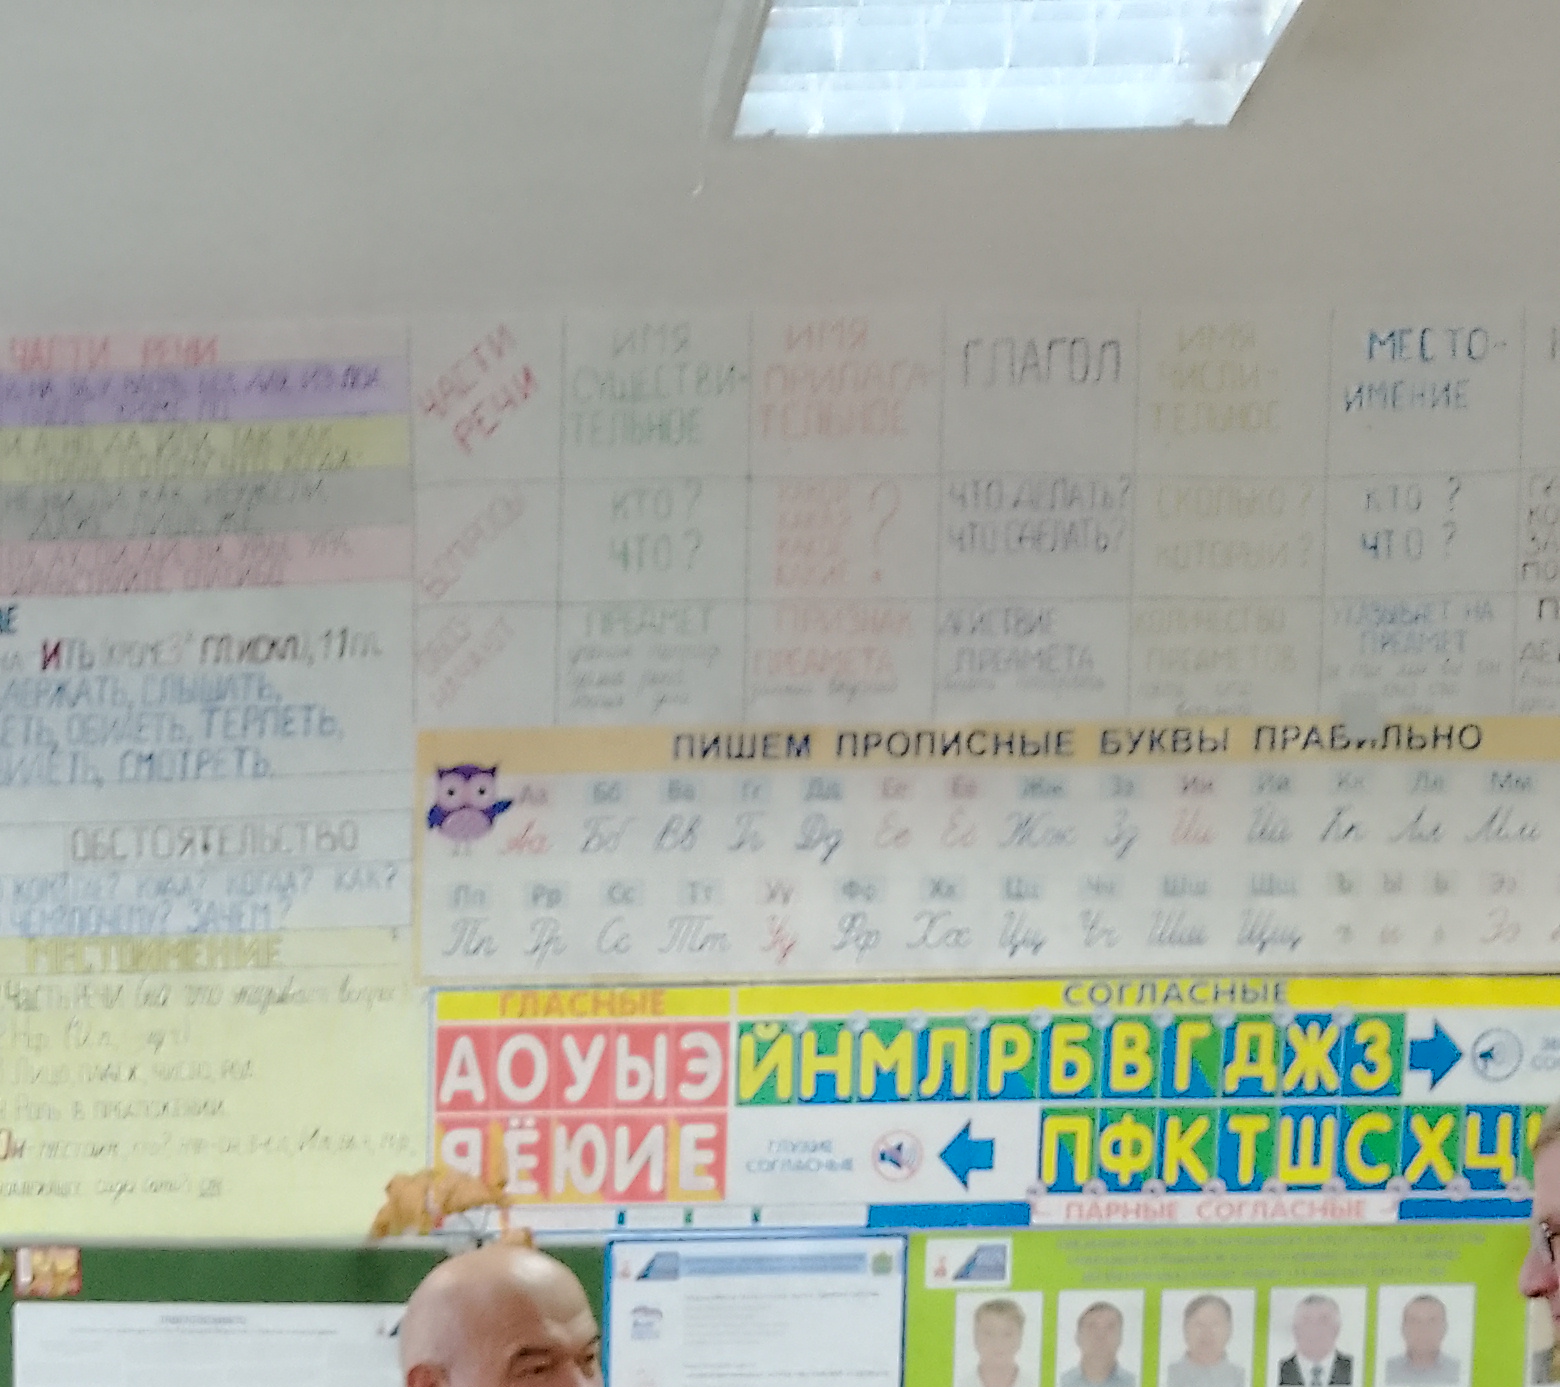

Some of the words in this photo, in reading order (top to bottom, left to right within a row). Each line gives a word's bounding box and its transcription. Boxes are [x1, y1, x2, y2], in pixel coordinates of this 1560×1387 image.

[612, 321, 690, 359] ИМЯ
[784, 317, 870, 353] ИМЯ
[1366, 325, 1508, 363] МЕСТО-
[962, 335, 1122, 387] ГЛАГОЛ
[1343, 375, 1471, 414] ИМЕНИЕ
[673, 729, 812, 761] ПИШЕМ
[836, 722, 1075, 760] ПРОПИСНЫЕ
[1100, 724, 1230, 758] БУКВЫ
[70, 820, 360, 863] ОБСТОЯТЕЛЬСТВО
[25, 936, 283, 973] МЕСТОИМЕНИЕ
[497, 989, 667, 1018] ГЛАСНЫЕ
[1062, 980, 1289, 1006] СОГЛАСНЫЕ
[1064, 1200, 1178, 1222] ПАРНЫЕ
[1195, 1197, 1366, 1220] СОГЛАСНЫЕ
